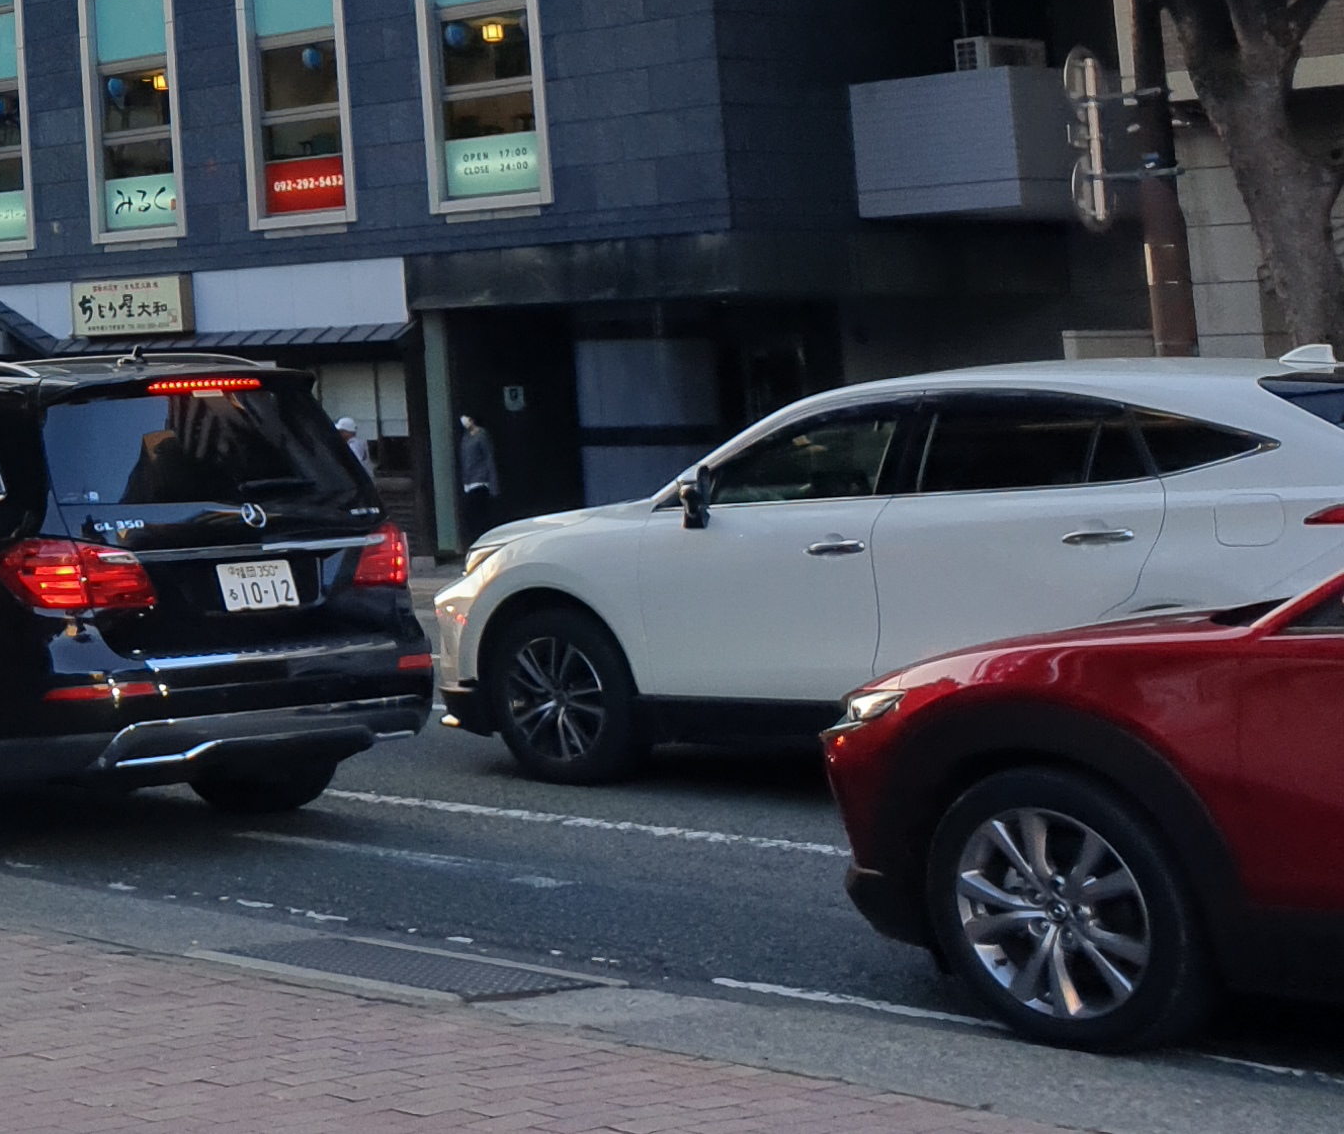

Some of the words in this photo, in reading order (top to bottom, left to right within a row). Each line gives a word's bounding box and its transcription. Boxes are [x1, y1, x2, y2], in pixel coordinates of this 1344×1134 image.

[463, 151, 489, 163] OPEN
[499, 147, 528, 159] 17:00
[464, 164, 490, 176] CLOSE
[499, 161, 528, 173] 24:00
[273, 174, 343, 192] 092-292-5432
[115, 186, 169, 215] みるく
[94, 521, 114, 533] GL
[116, 519, 145, 530] 350
[240, 579, 294, 606] 10-12
